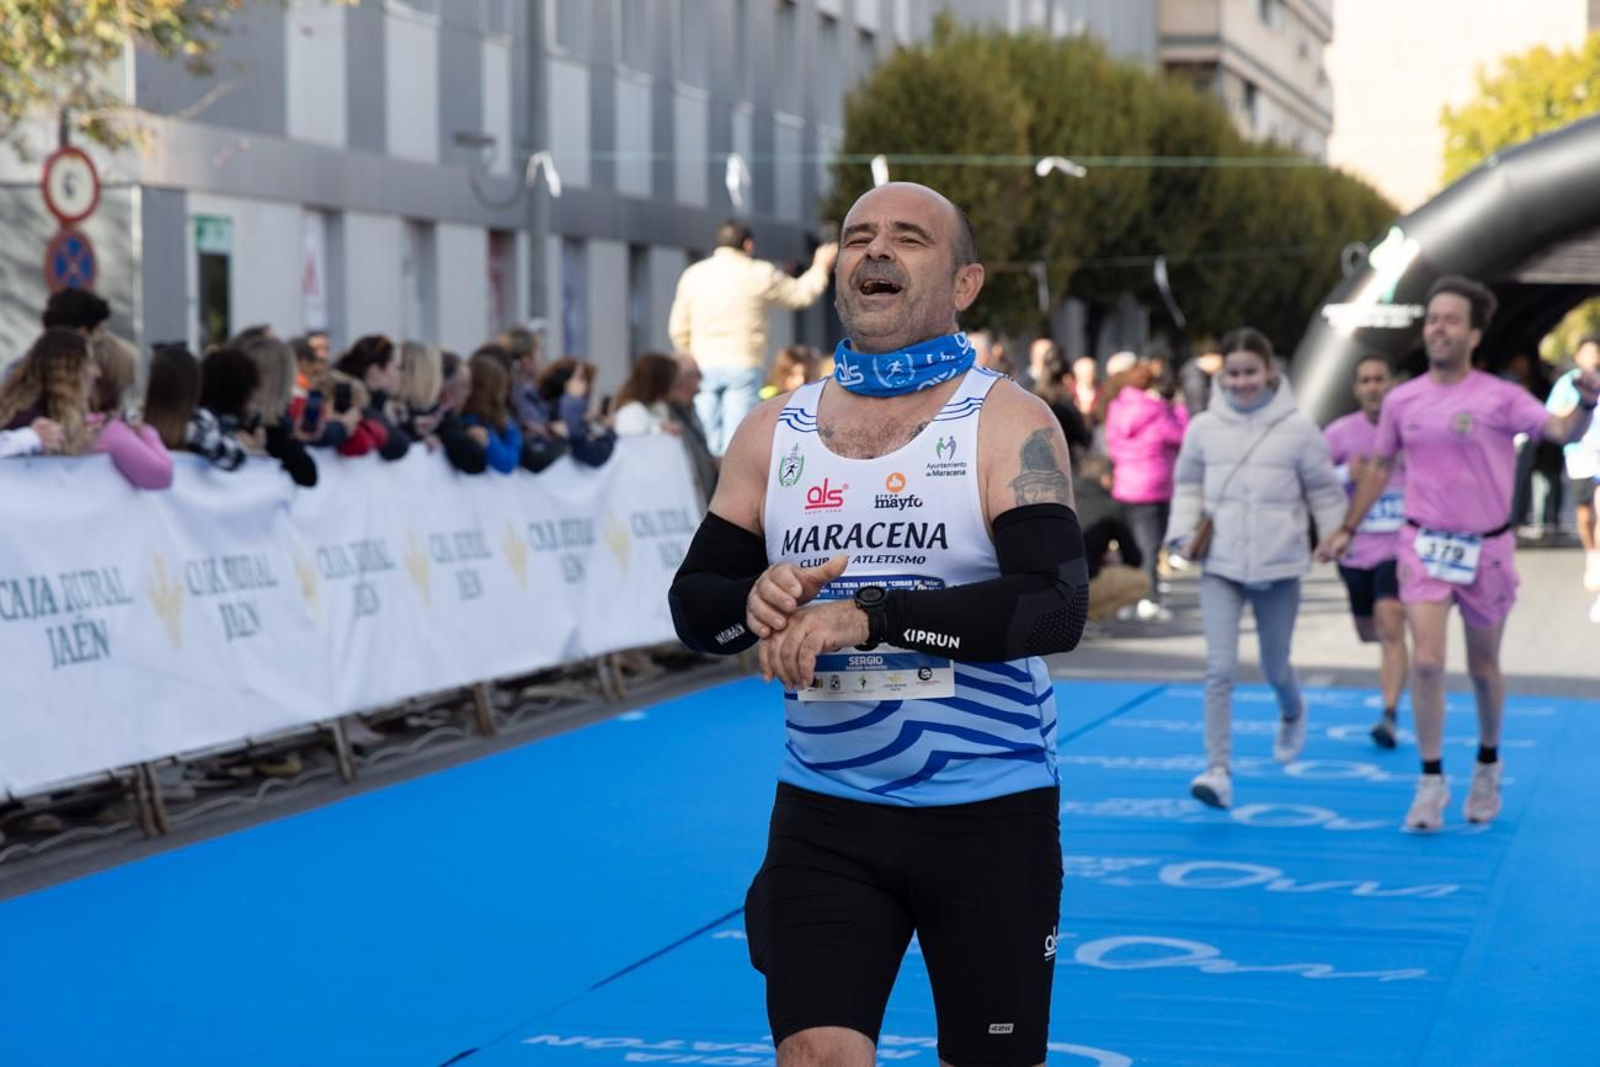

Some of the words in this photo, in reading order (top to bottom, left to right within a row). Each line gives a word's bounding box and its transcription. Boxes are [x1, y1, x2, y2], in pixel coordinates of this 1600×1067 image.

[926, 462, 967, 470] Ayuntamiento
[805, 478, 843, 509] als
[874, 494, 924, 511] mayfo
[781, 522, 948, 556] MARACENA
[852, 555, 926, 565] ATLETISMO
[903, 628, 961, 649] KIPRUN
[848, 655, 884, 666] SERGIO
